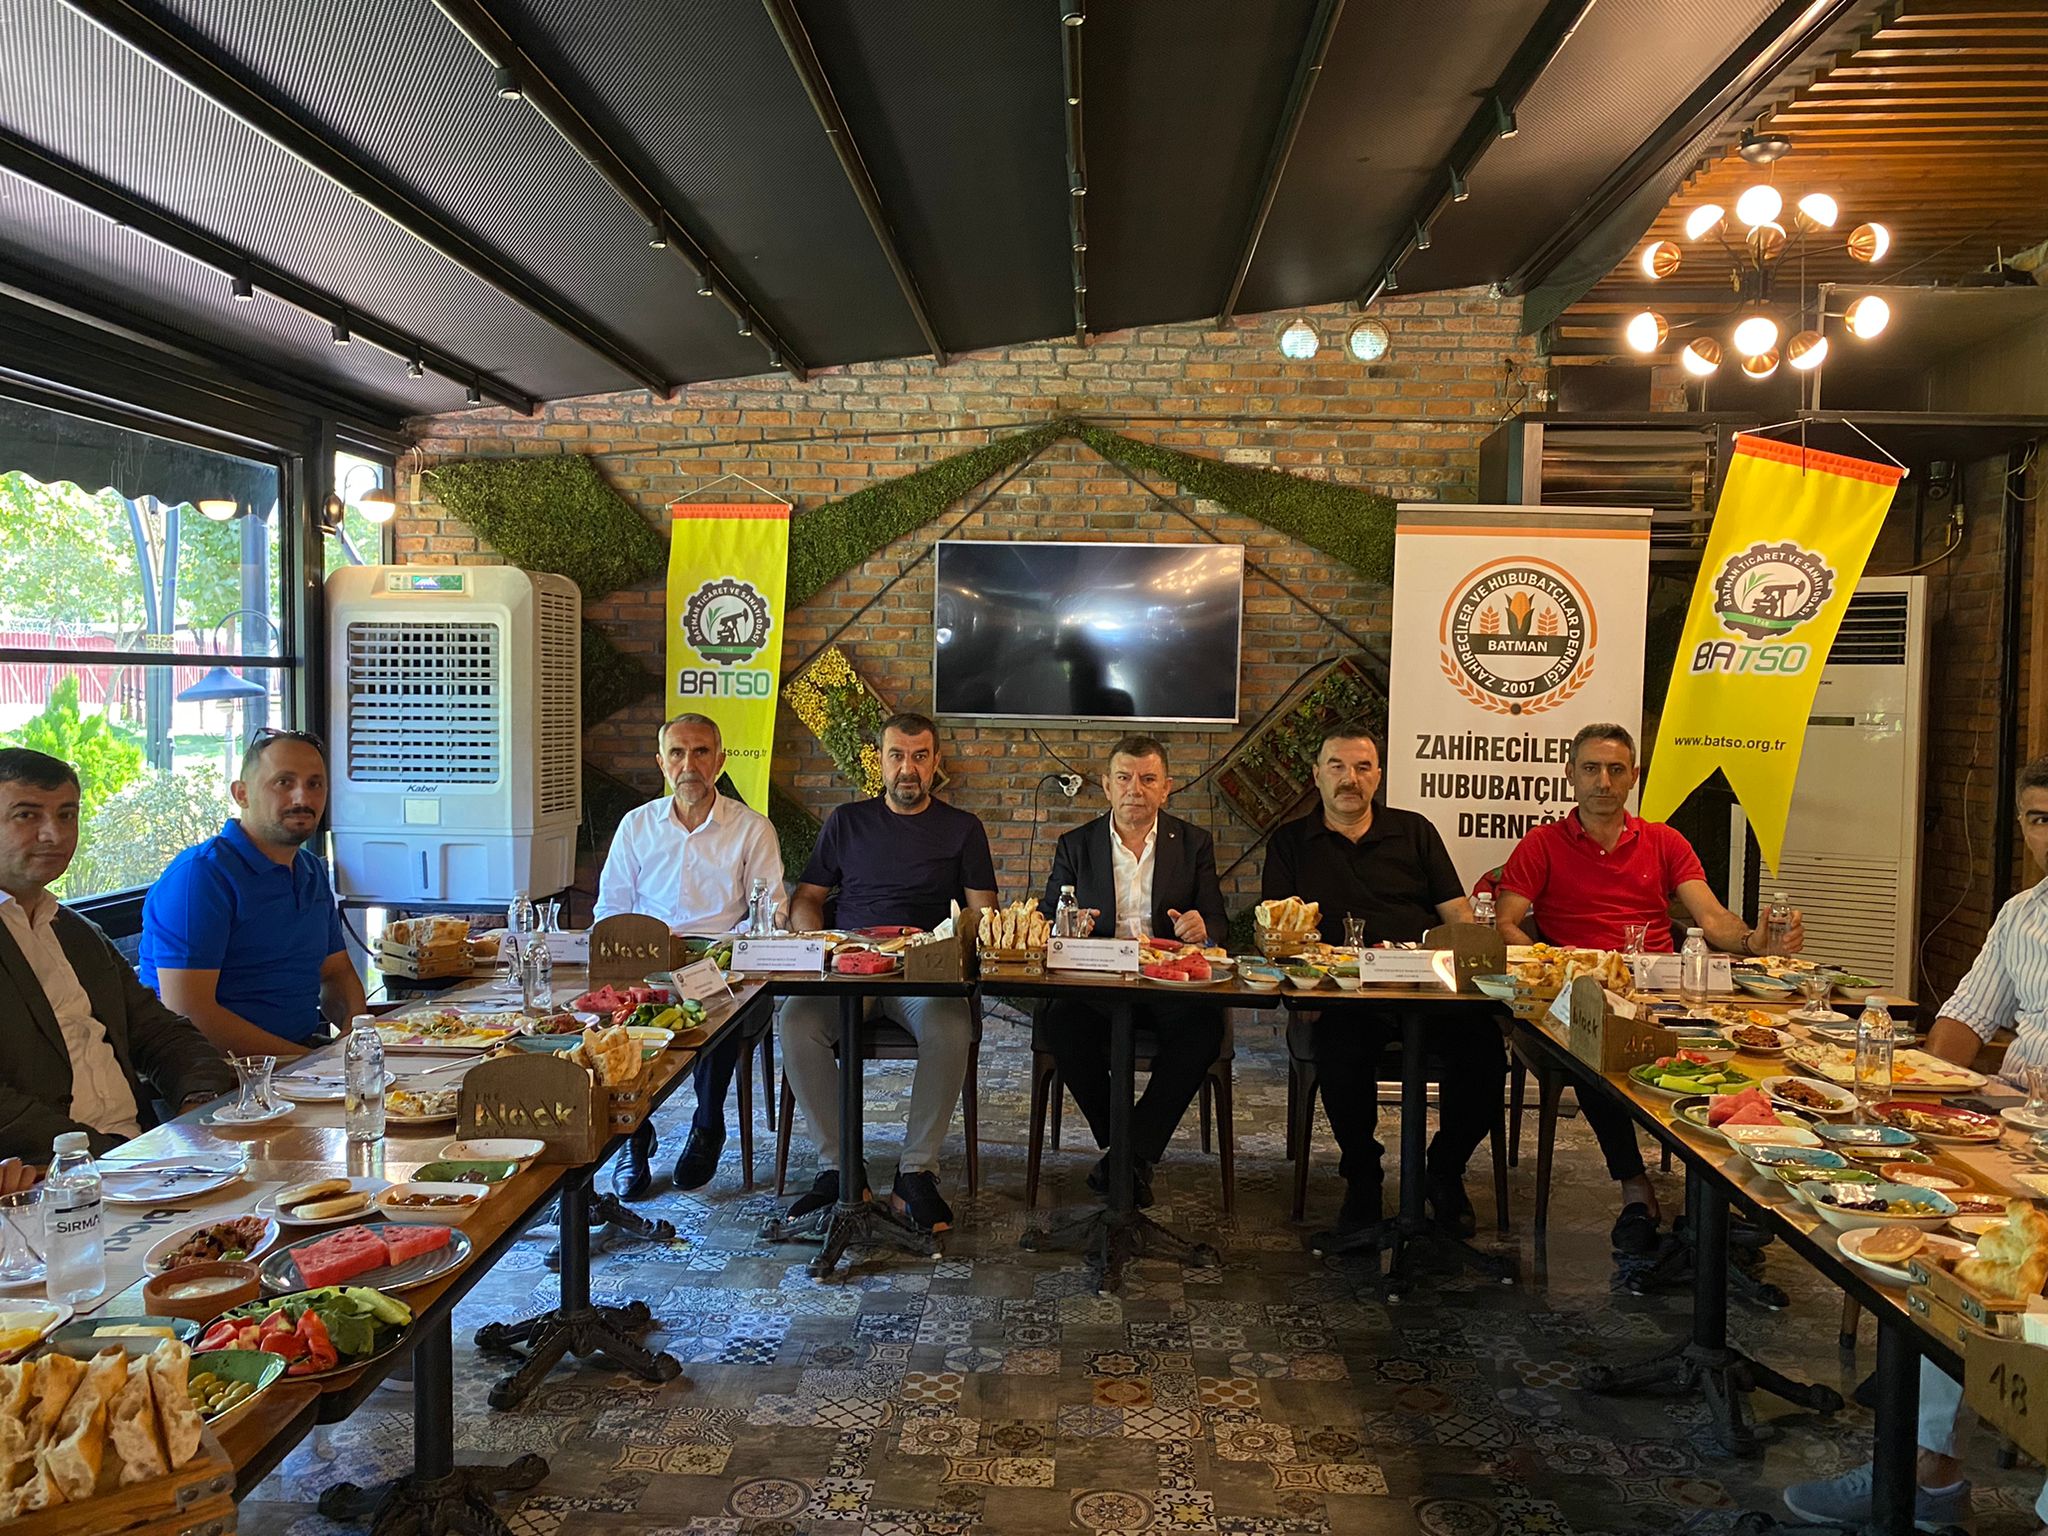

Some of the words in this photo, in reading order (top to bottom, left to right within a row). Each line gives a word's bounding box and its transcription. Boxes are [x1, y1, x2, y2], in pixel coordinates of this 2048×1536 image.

[1788, 554, 1803, 566] VE
[1469, 585, 1489, 603] VE
[1487, 572, 1579, 627] HUBUBATÇILAR
[1454, 604, 1497, 688] ZAHİRECİLER
[1488, 640, 1548, 653] BATMAN
[1692, 641, 1808, 673] BATSO
[1543, 629, 1581, 688] DERNEĞİ
[680, 670, 770, 696] BATSO
[1501, 681, 1536, 694] 2007
[1415, 730, 1574, 764] ZAHİRECİLER
[1674, 735, 1787, 753] www.batso.org.tr
[406, 784, 439, 793] Kabel
[1420, 773, 1578, 805] HUBUBATÇIL
[925, 952, 944, 969] 12
[56, 1213, 101, 1234] SIRMA
[1989, 1362, 2028, 1417] 18
